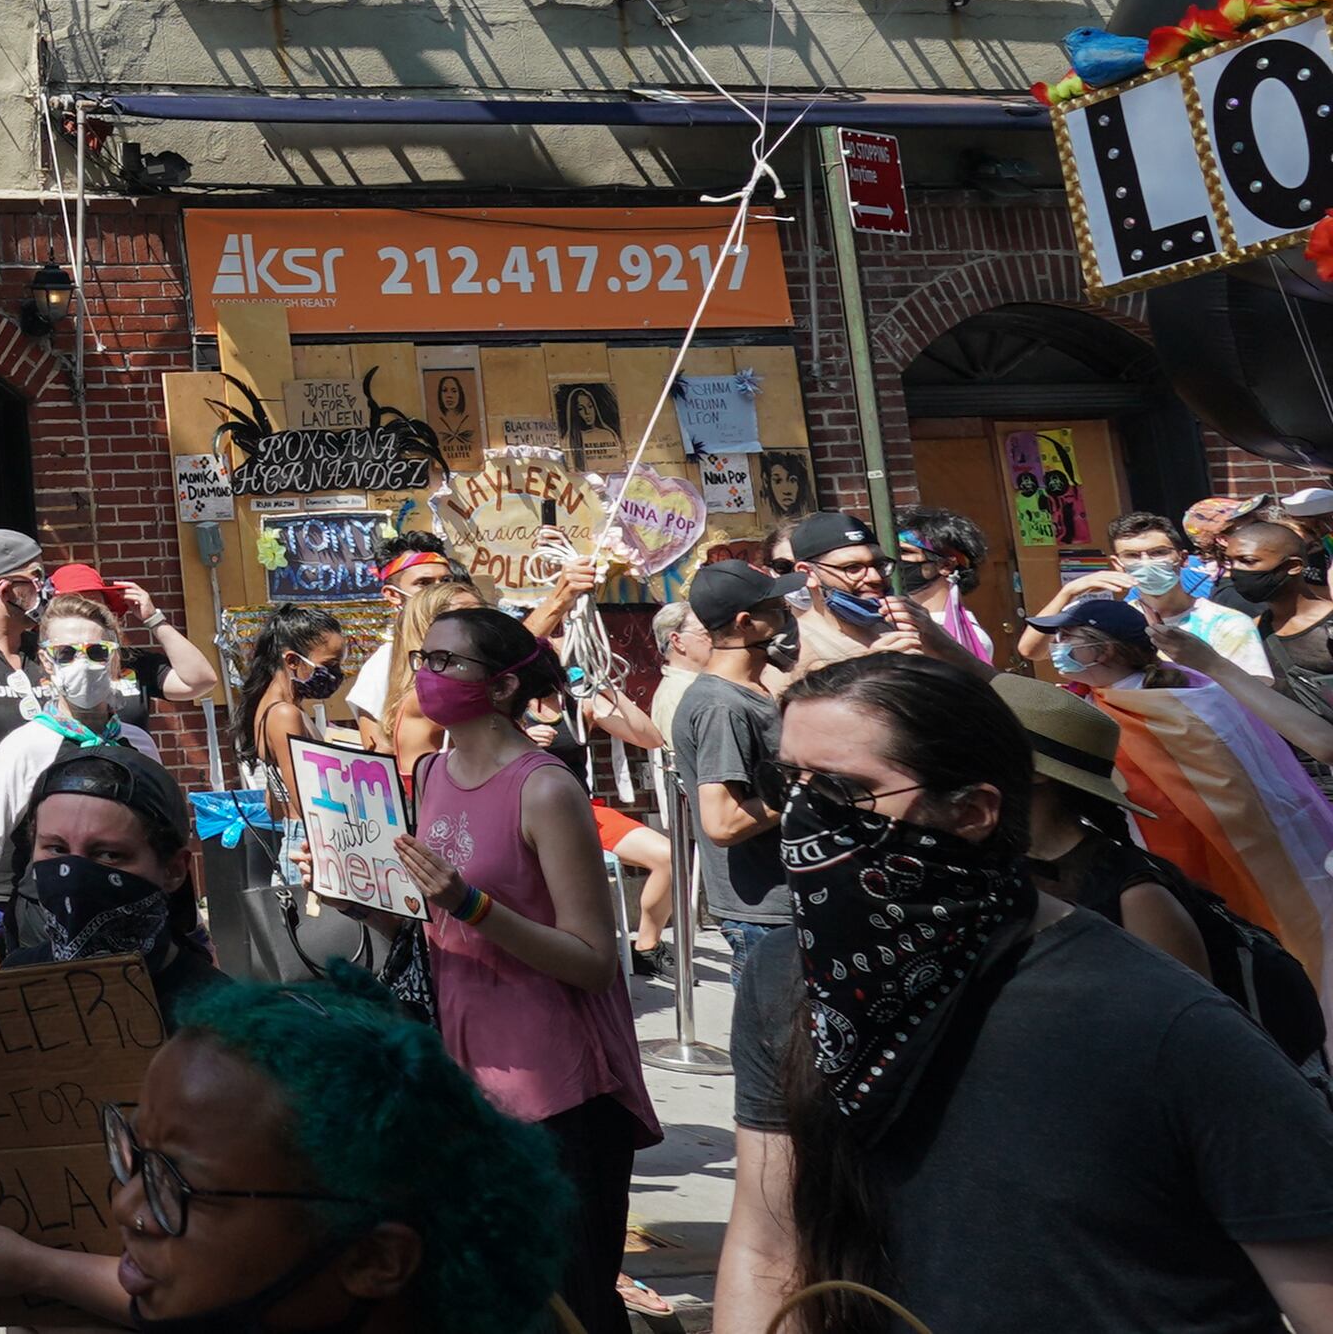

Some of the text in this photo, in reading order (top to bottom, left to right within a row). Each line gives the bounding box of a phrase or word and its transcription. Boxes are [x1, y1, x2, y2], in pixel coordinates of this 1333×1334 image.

[856, 142, 891, 164] STOPPING
[377, 243, 750, 295] 212.417.9217
[300, 298, 337, 308] REALTY
[303, 382, 352, 399] JUSTICE
[321, 399, 345, 410] FOR
[301, 409, 364, 428] LAYLEEN
[259, 427, 398, 463] ROXSANA
[178, 469, 220, 485] MONIKA
[232, 458, 429, 496] HERNANDEZ
[704, 469, 748, 486] NINA POP
[188, 485, 232, 501] DIAMOND
[447, 465, 585, 520] LAYLEEN
[618, 500, 659, 524] NINA
[665, 513, 696, 535] POP
[273, 559, 382, 594] MCDAD
[328, 794, 381, 853] with
[307, 811, 409, 910] her
